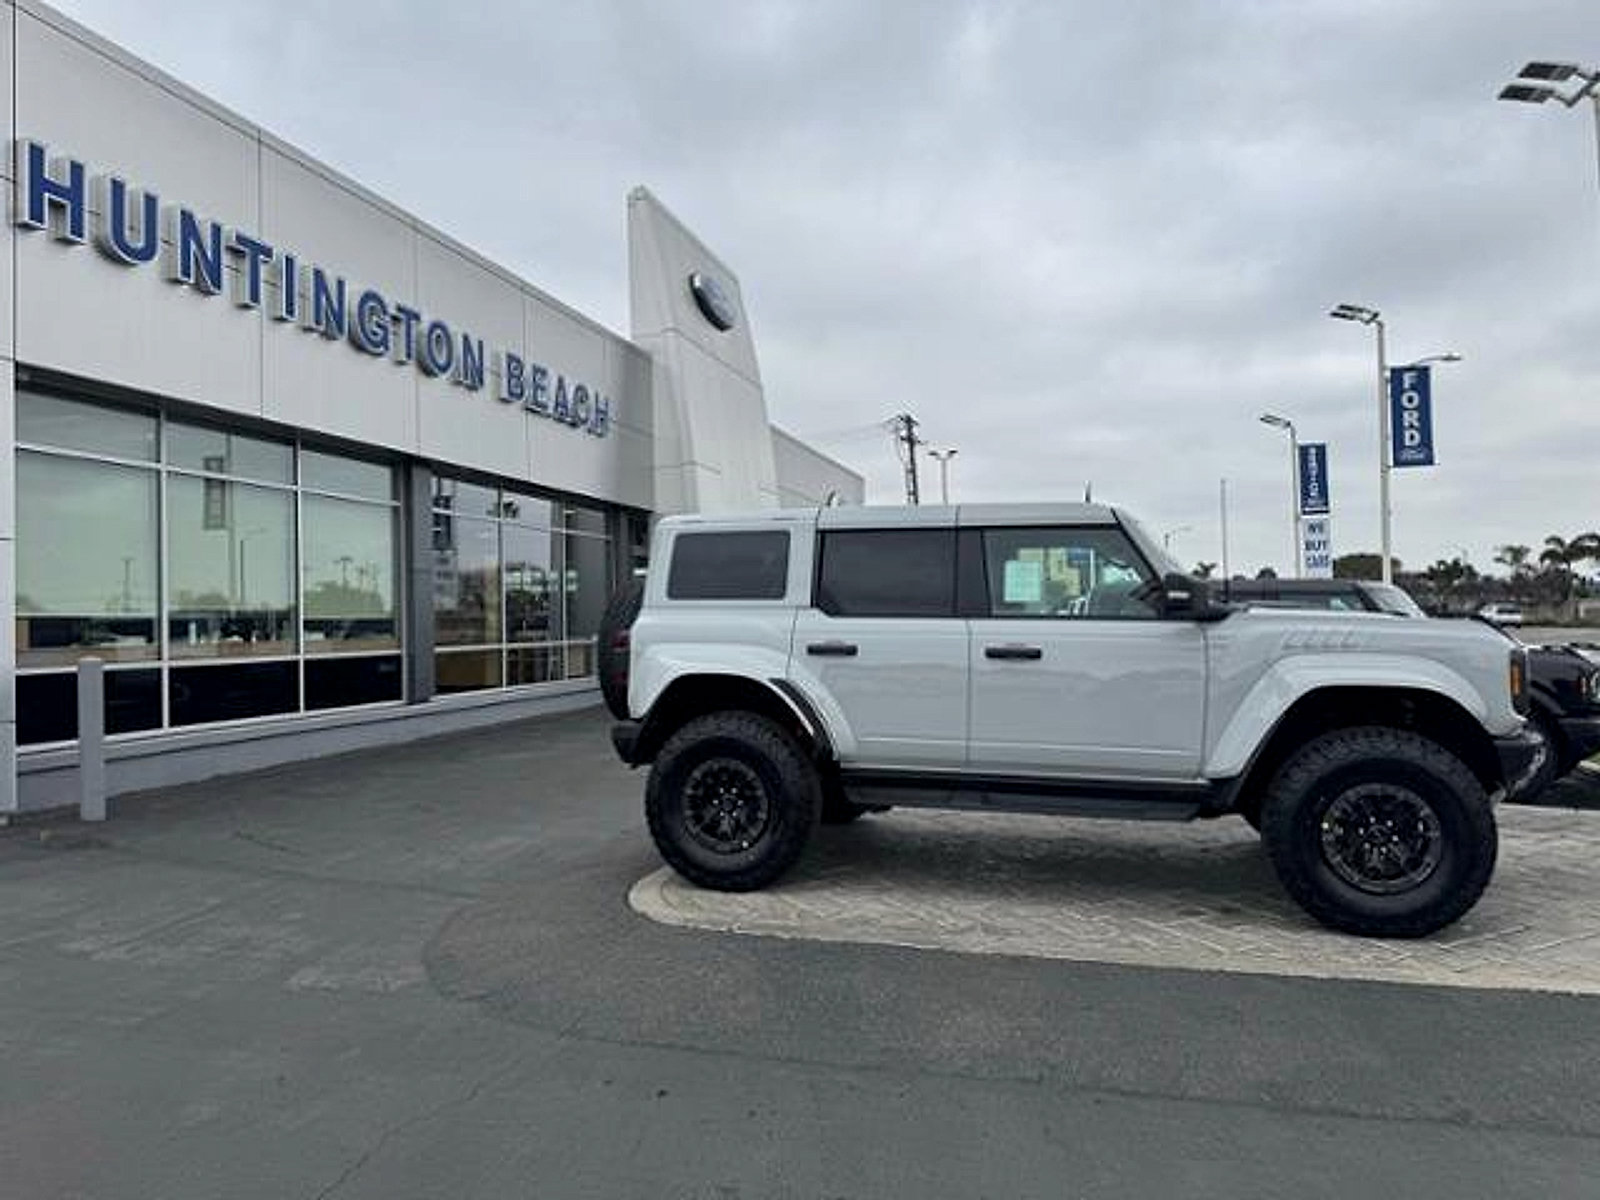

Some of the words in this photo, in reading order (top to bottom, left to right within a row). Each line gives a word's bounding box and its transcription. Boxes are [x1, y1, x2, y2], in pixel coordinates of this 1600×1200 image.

[22, 140, 486, 392] HUNTINGTON
[503, 351, 612, 438] BEACH
[1401, 372, 1422, 447] FORD
